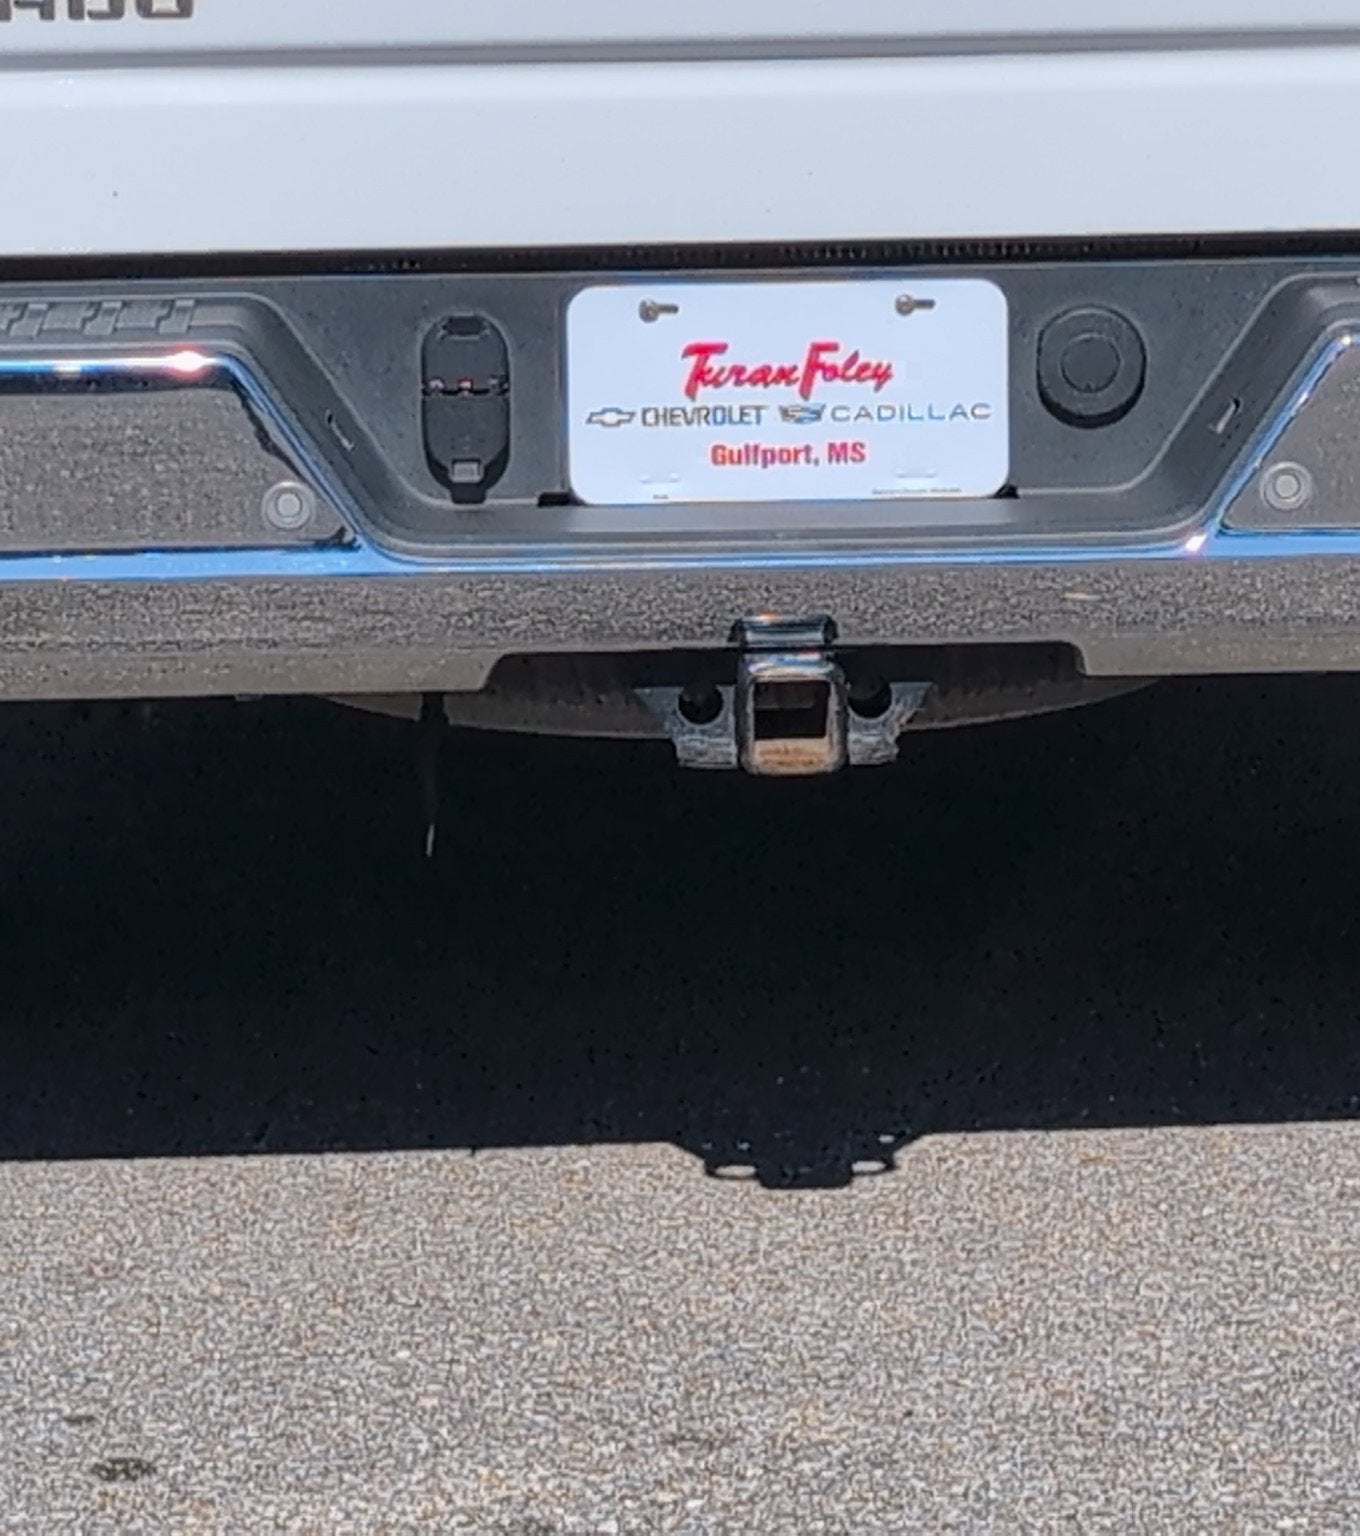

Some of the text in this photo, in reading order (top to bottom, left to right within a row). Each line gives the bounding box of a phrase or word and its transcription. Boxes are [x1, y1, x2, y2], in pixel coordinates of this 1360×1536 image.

[641, 402, 993, 427] CHEVROLET CADILLAC
[828, 441, 867, 463] MS
